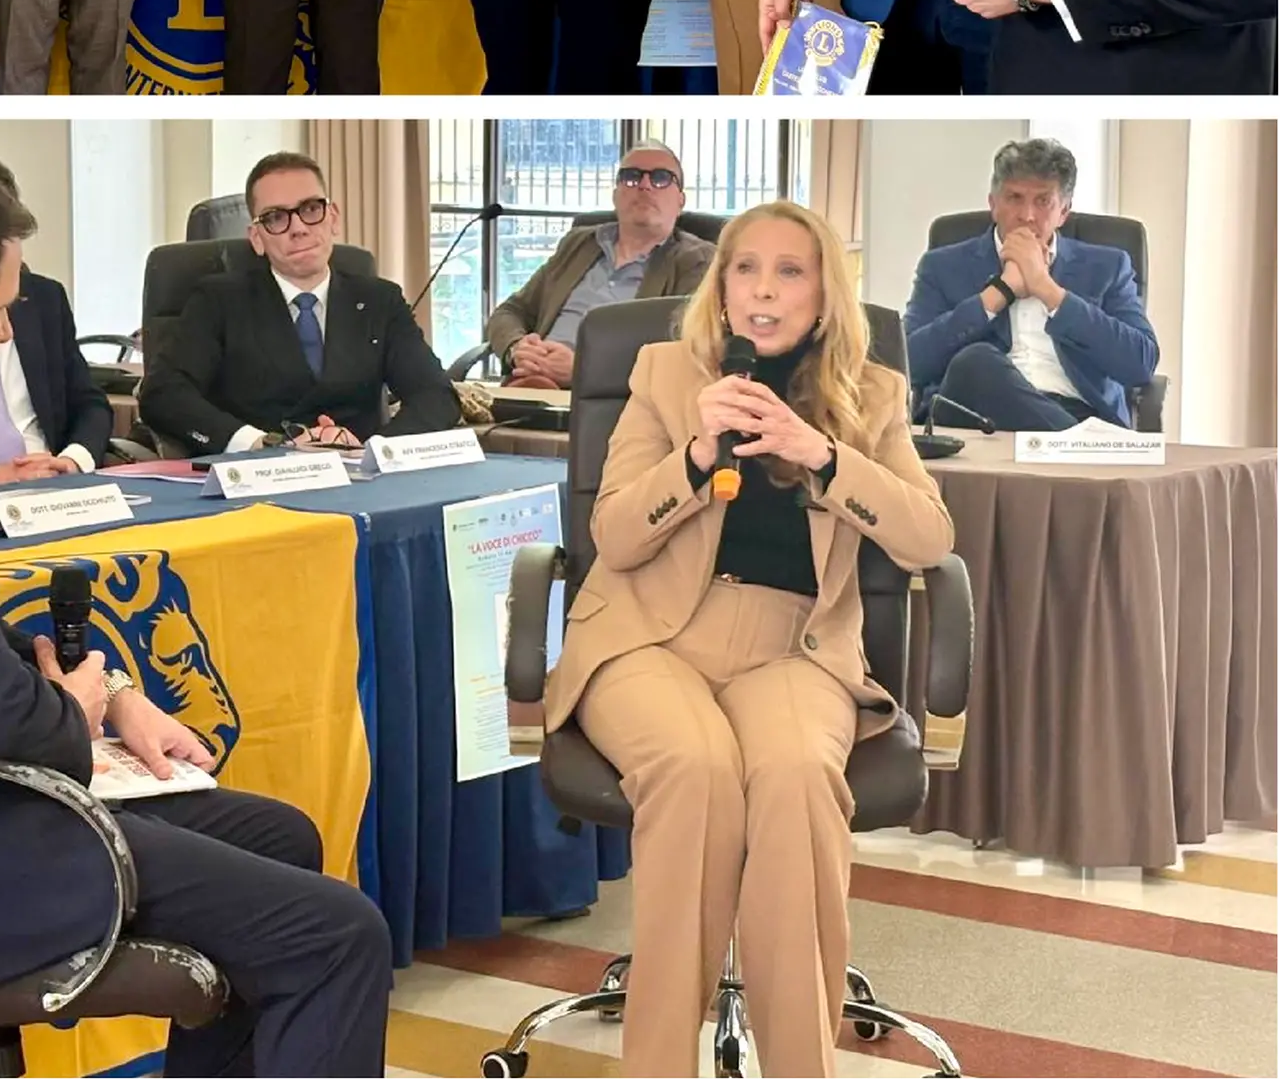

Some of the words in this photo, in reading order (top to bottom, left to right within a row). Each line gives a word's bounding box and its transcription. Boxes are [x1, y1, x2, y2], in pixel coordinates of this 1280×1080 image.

[1125, 441, 1161, 449] SALAZAR
[483, 539, 501, 552] VOCE
[503, 537, 511, 547] DI
